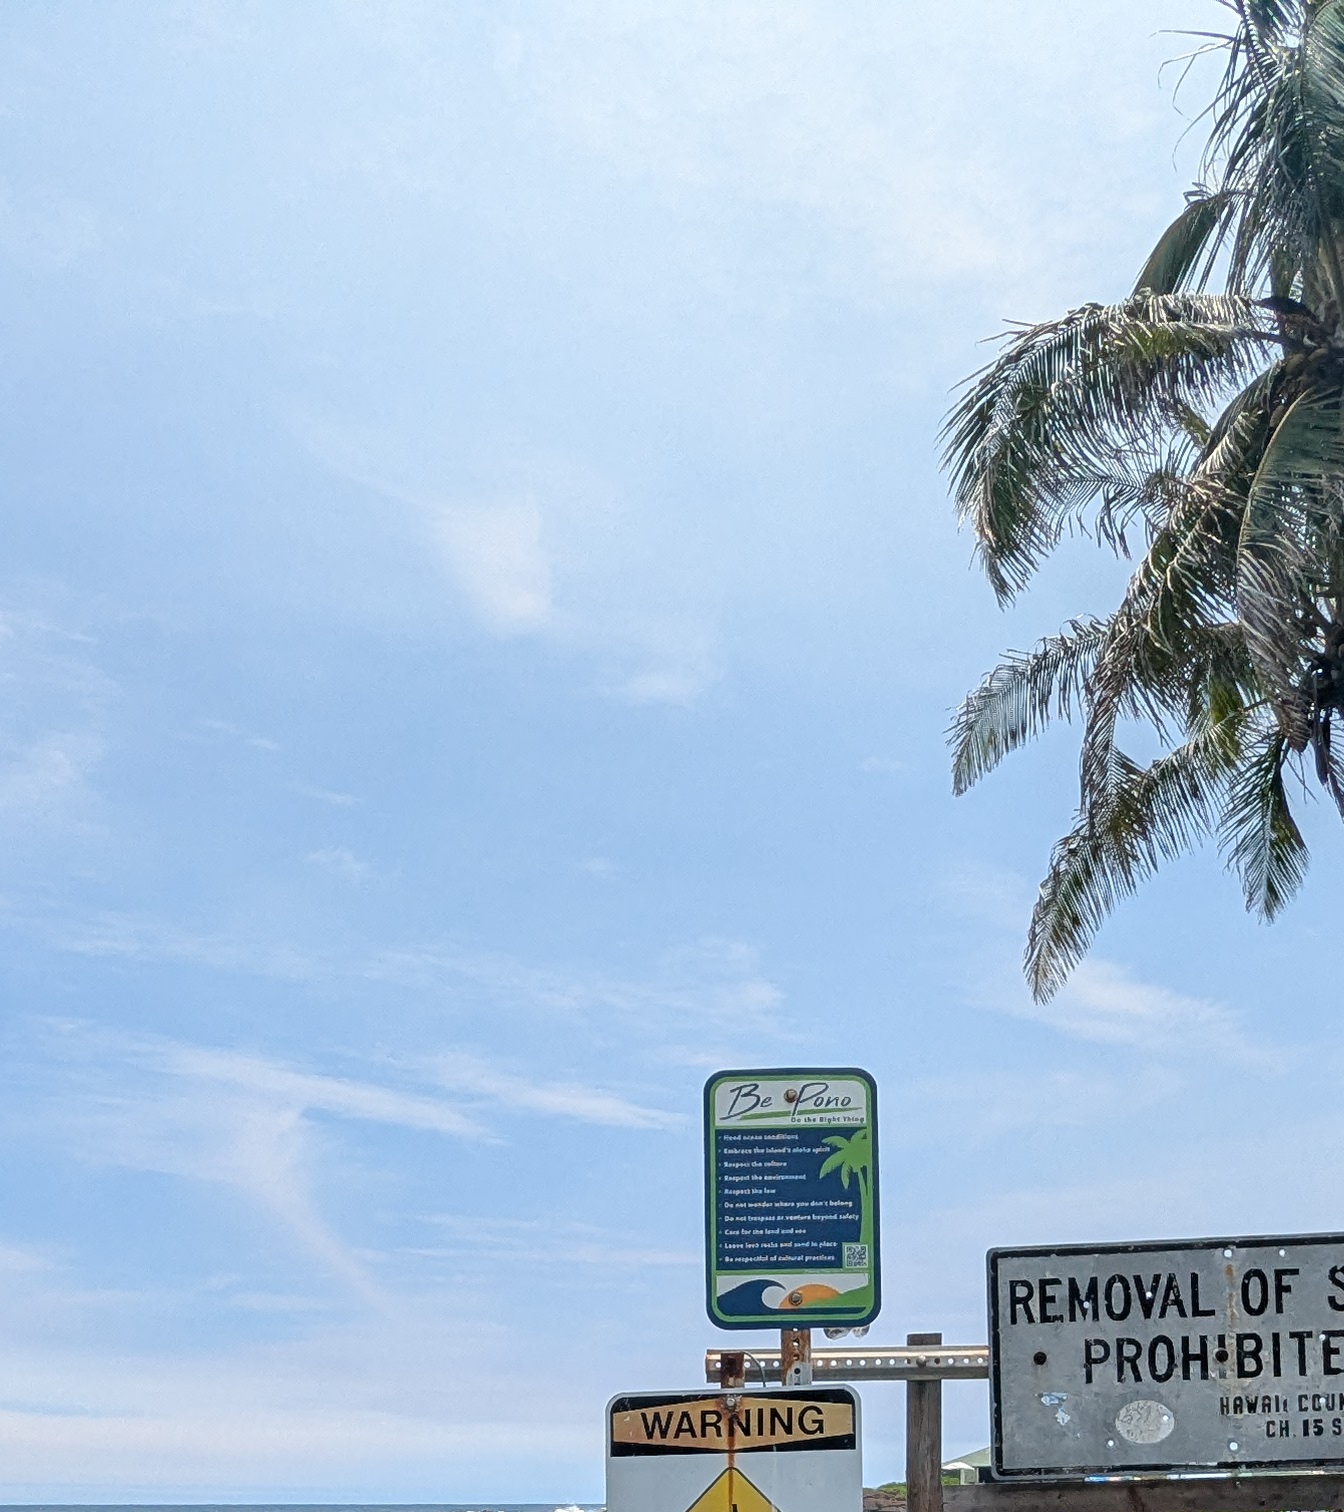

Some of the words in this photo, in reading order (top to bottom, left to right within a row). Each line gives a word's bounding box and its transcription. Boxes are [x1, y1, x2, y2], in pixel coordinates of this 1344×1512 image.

[719, 1083, 772, 1120] Be
[793, 1082, 851, 1116] Pono
[1008, 1271, 1216, 1325] REMOVAL
[1240, 1268, 1300, 1317] OF
[640, 1405, 825, 1440] WARNING
[1302, 1419, 1323, 1436] 15
